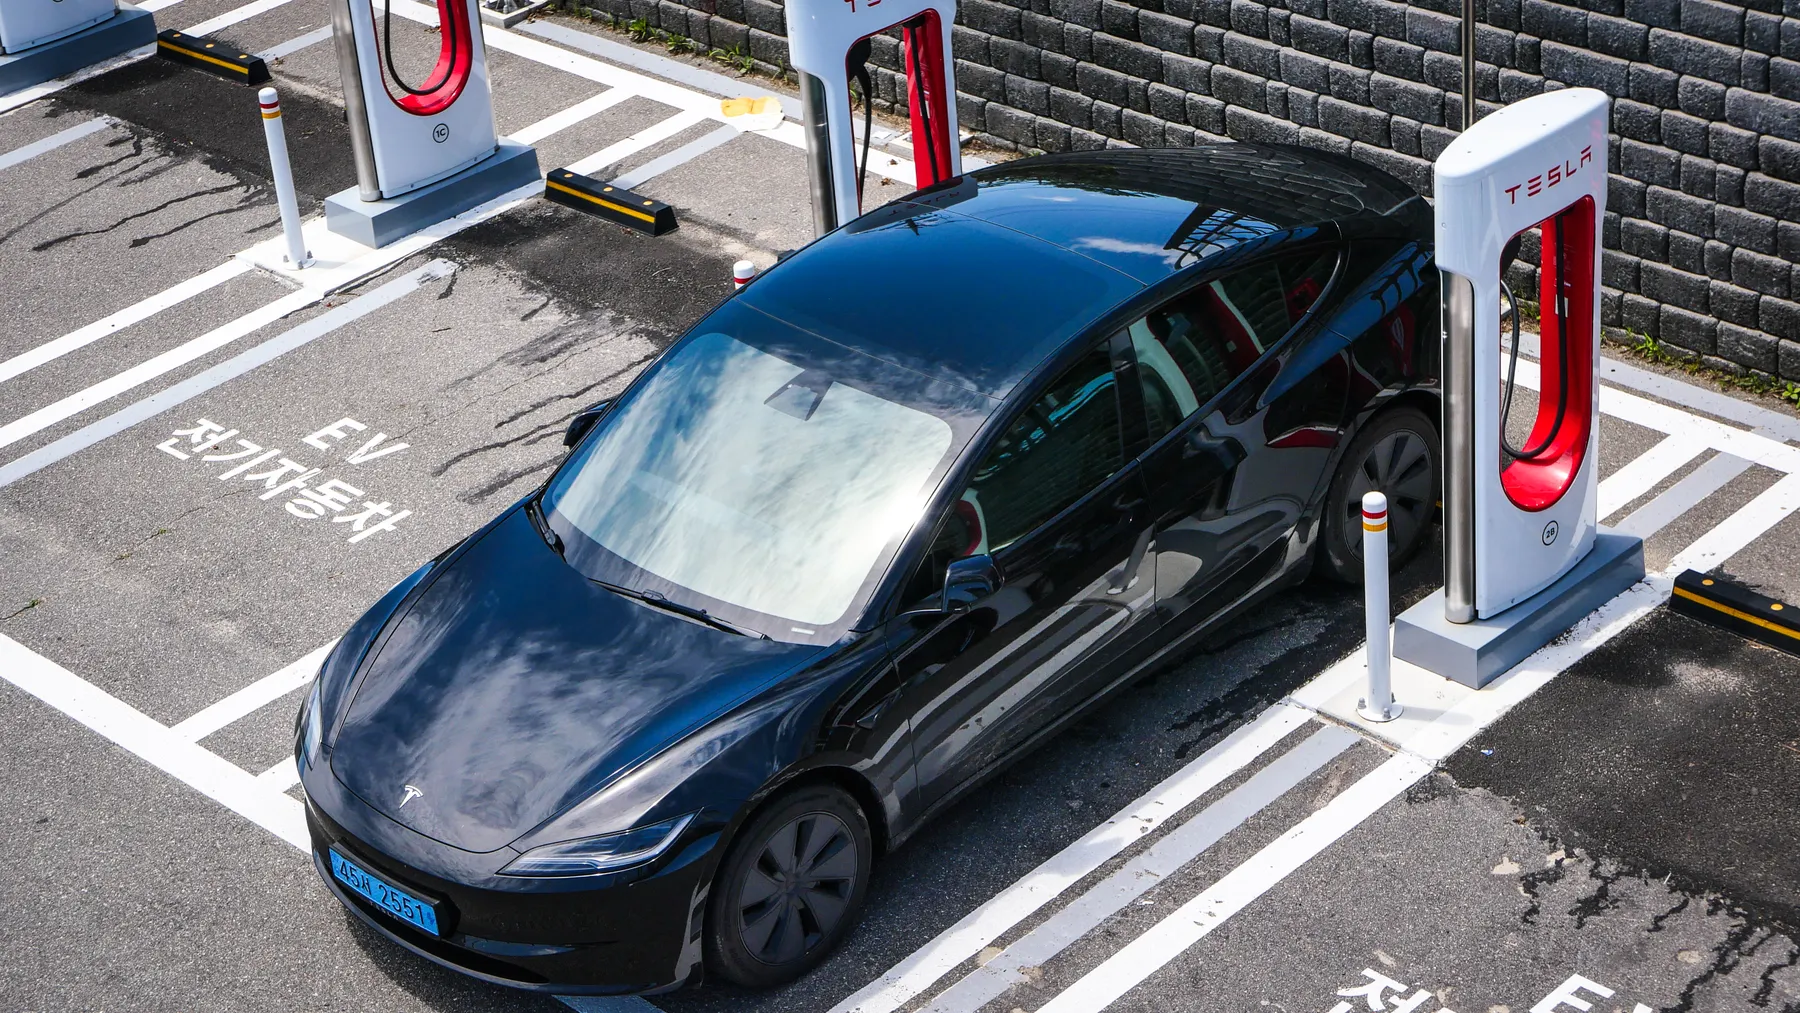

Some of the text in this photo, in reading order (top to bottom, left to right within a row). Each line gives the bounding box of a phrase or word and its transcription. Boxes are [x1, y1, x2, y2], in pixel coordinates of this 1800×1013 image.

[435, 128, 446, 138] 1C
[1504, 144, 1592, 205] TESLA
[301, 416, 411, 465] EV
[156, 417, 413, 543] 전기자동차
[1546, 527, 1555, 539] 2B
[378, 884, 425, 925] 2551
